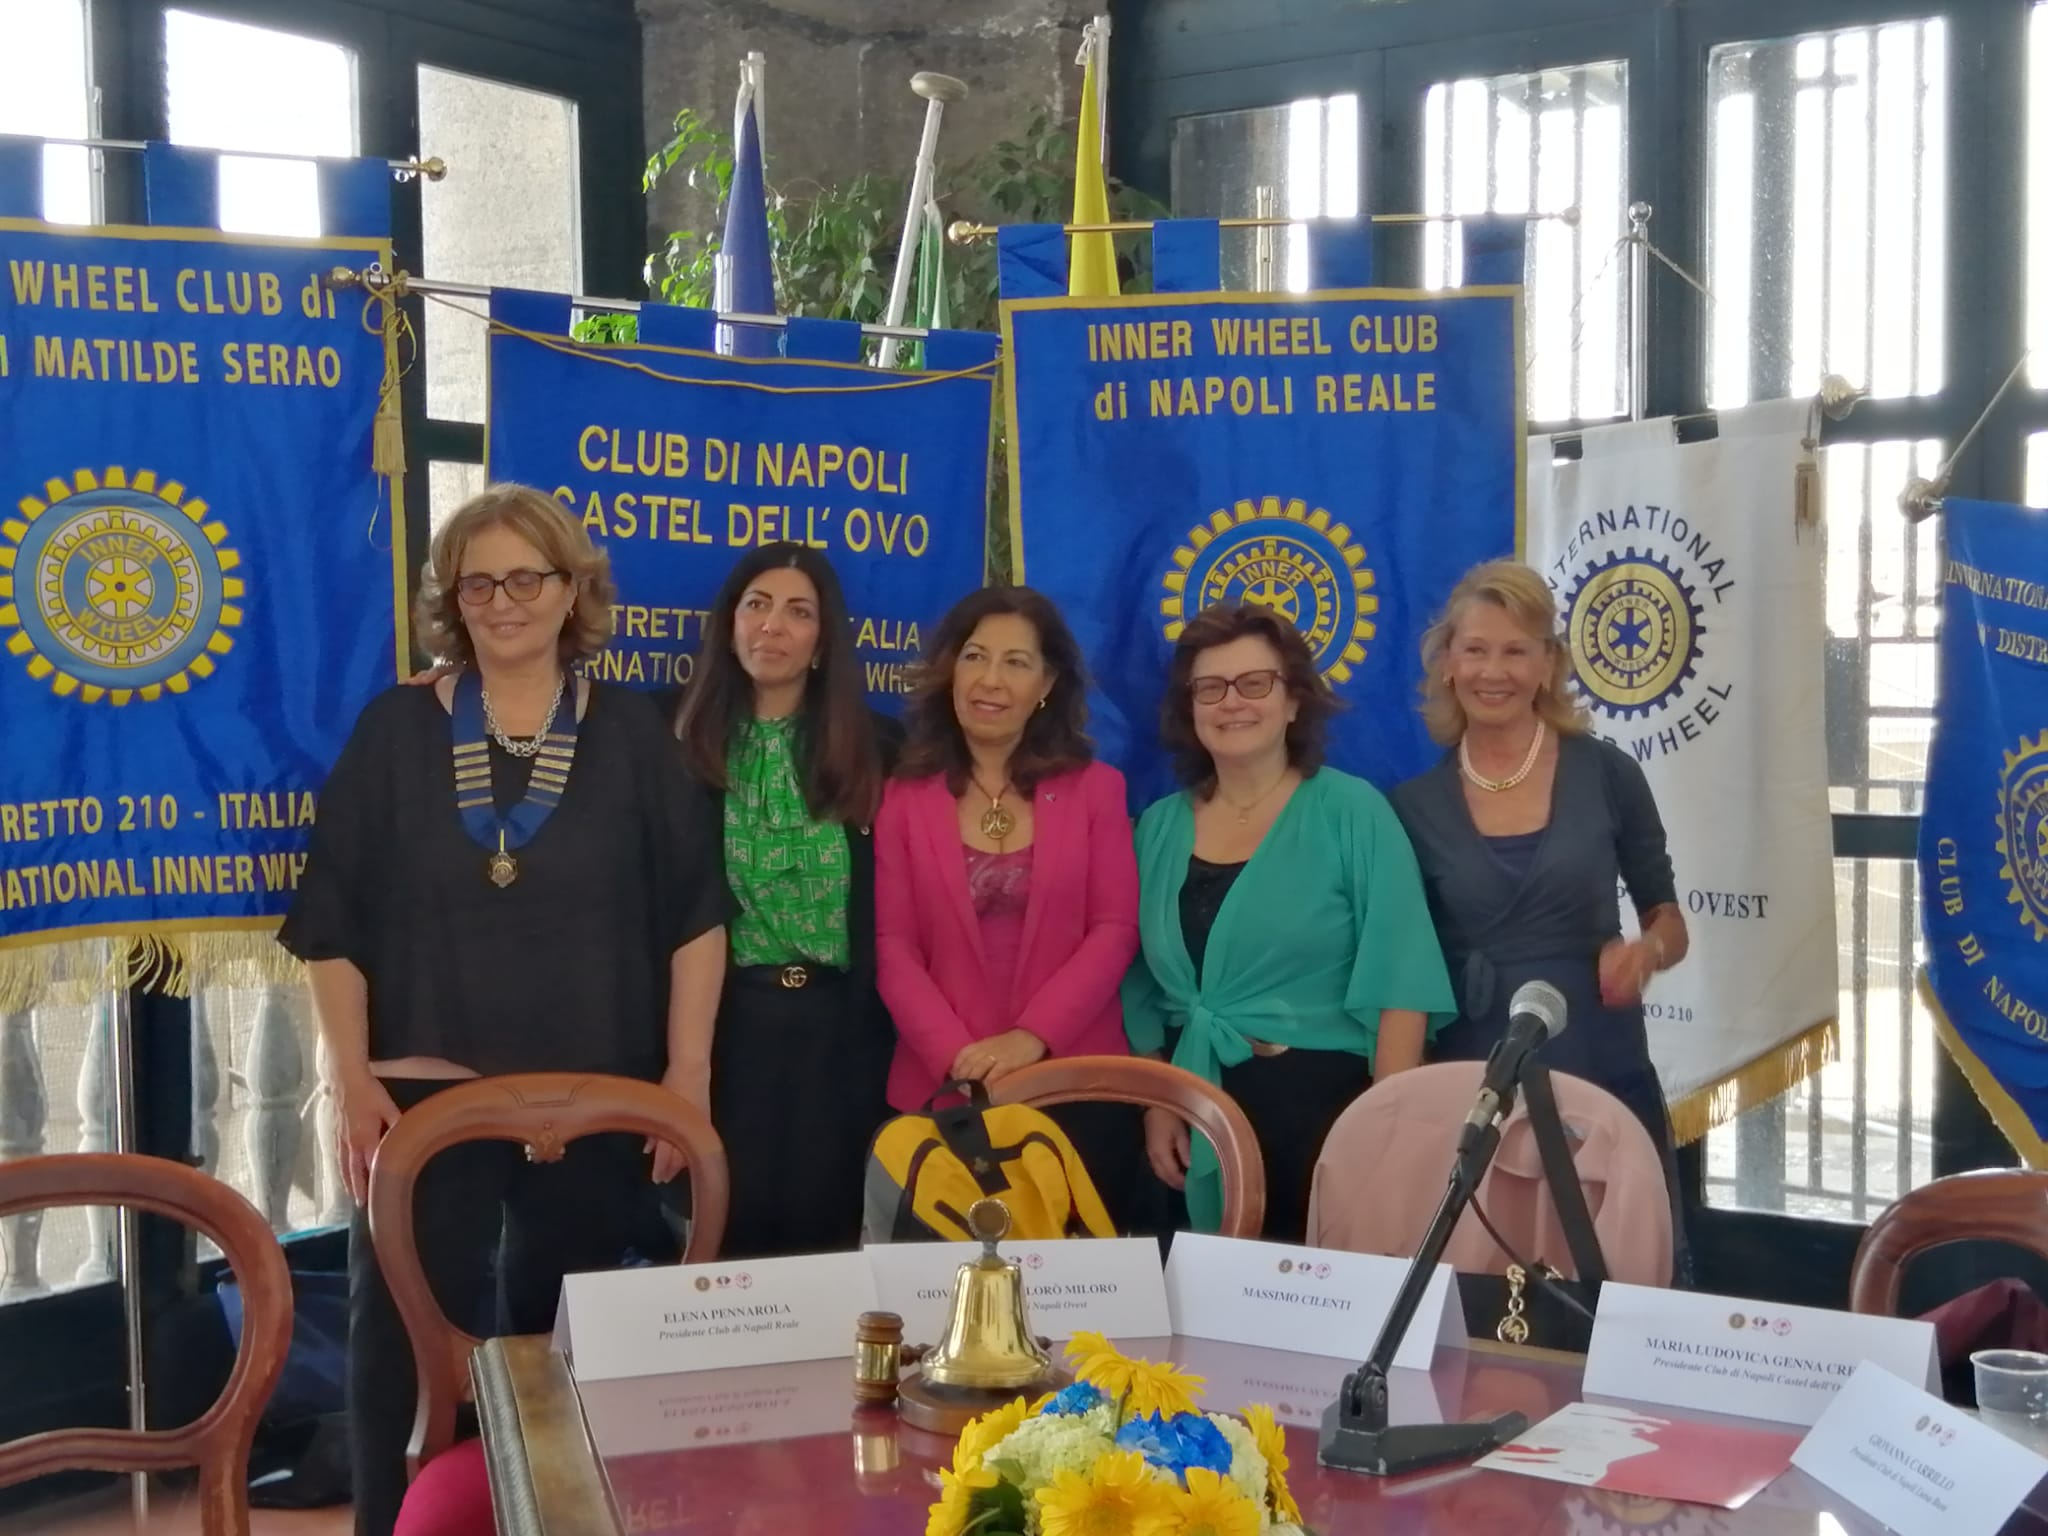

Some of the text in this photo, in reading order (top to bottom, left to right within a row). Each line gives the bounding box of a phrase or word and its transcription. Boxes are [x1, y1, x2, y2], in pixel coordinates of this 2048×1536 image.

[10, 260, 159, 313] WHEEL
[176, 268, 282, 317] CLUB
[1087, 315, 1438, 362] INNER WHEEL CLUB
[34, 335, 200, 384] MATILDE
[223, 342, 341, 388] SERAO
[1094, 373, 1437, 421] di NAPOLI REALE
[578, 425, 909, 495] CLUB DI NAPOLI
[78, 535, 160, 565] INNER
[844, 508, 930, 557] OVO
[1237, 560, 1304, 587] INNER
[1548, 505, 1735, 604] NTERNATIONAL
[78, 607, 164, 642] WHEEL
[608, 605, 712, 641] TRETT
[1995, 627, 2048, 664] DISTR
[1632, 683, 1732, 763] WHEEL
[0, 797, 103, 842] RETTO
[118, 794, 178, 831] 210
[219, 791, 317, 830] ITALIA
[152, 855, 254, 895] INNER
[260, 853, 308, 891] WH
[1688, 890, 1768, 919] OVEST
[1937, 837, 2048, 1042] CLUB DI NAPOL
[1667, 1004, 1693, 1023] 210
[916, 1282, 1118, 1300] GIOV LORÒ MILORO
[1242, 1286, 1352, 1311] MASSIMO CILENTI
[659, 1319, 800, 1340] Presidente Club di Napoli Reale
[663, 1303, 792, 1324] ELENA PENNAROLA
[1645, 1336, 1857, 1378] MARIA LUDOVICA GENNA CRE
[1653, 1356, 1703, 1373] Presidente
[1704, 1363, 1729, 1378] Club
[1730, 1367, 1740, 1378] di
[1743, 1370, 1775, 1384] Napoli
[1777, 1374, 1809, 1389] Castel
